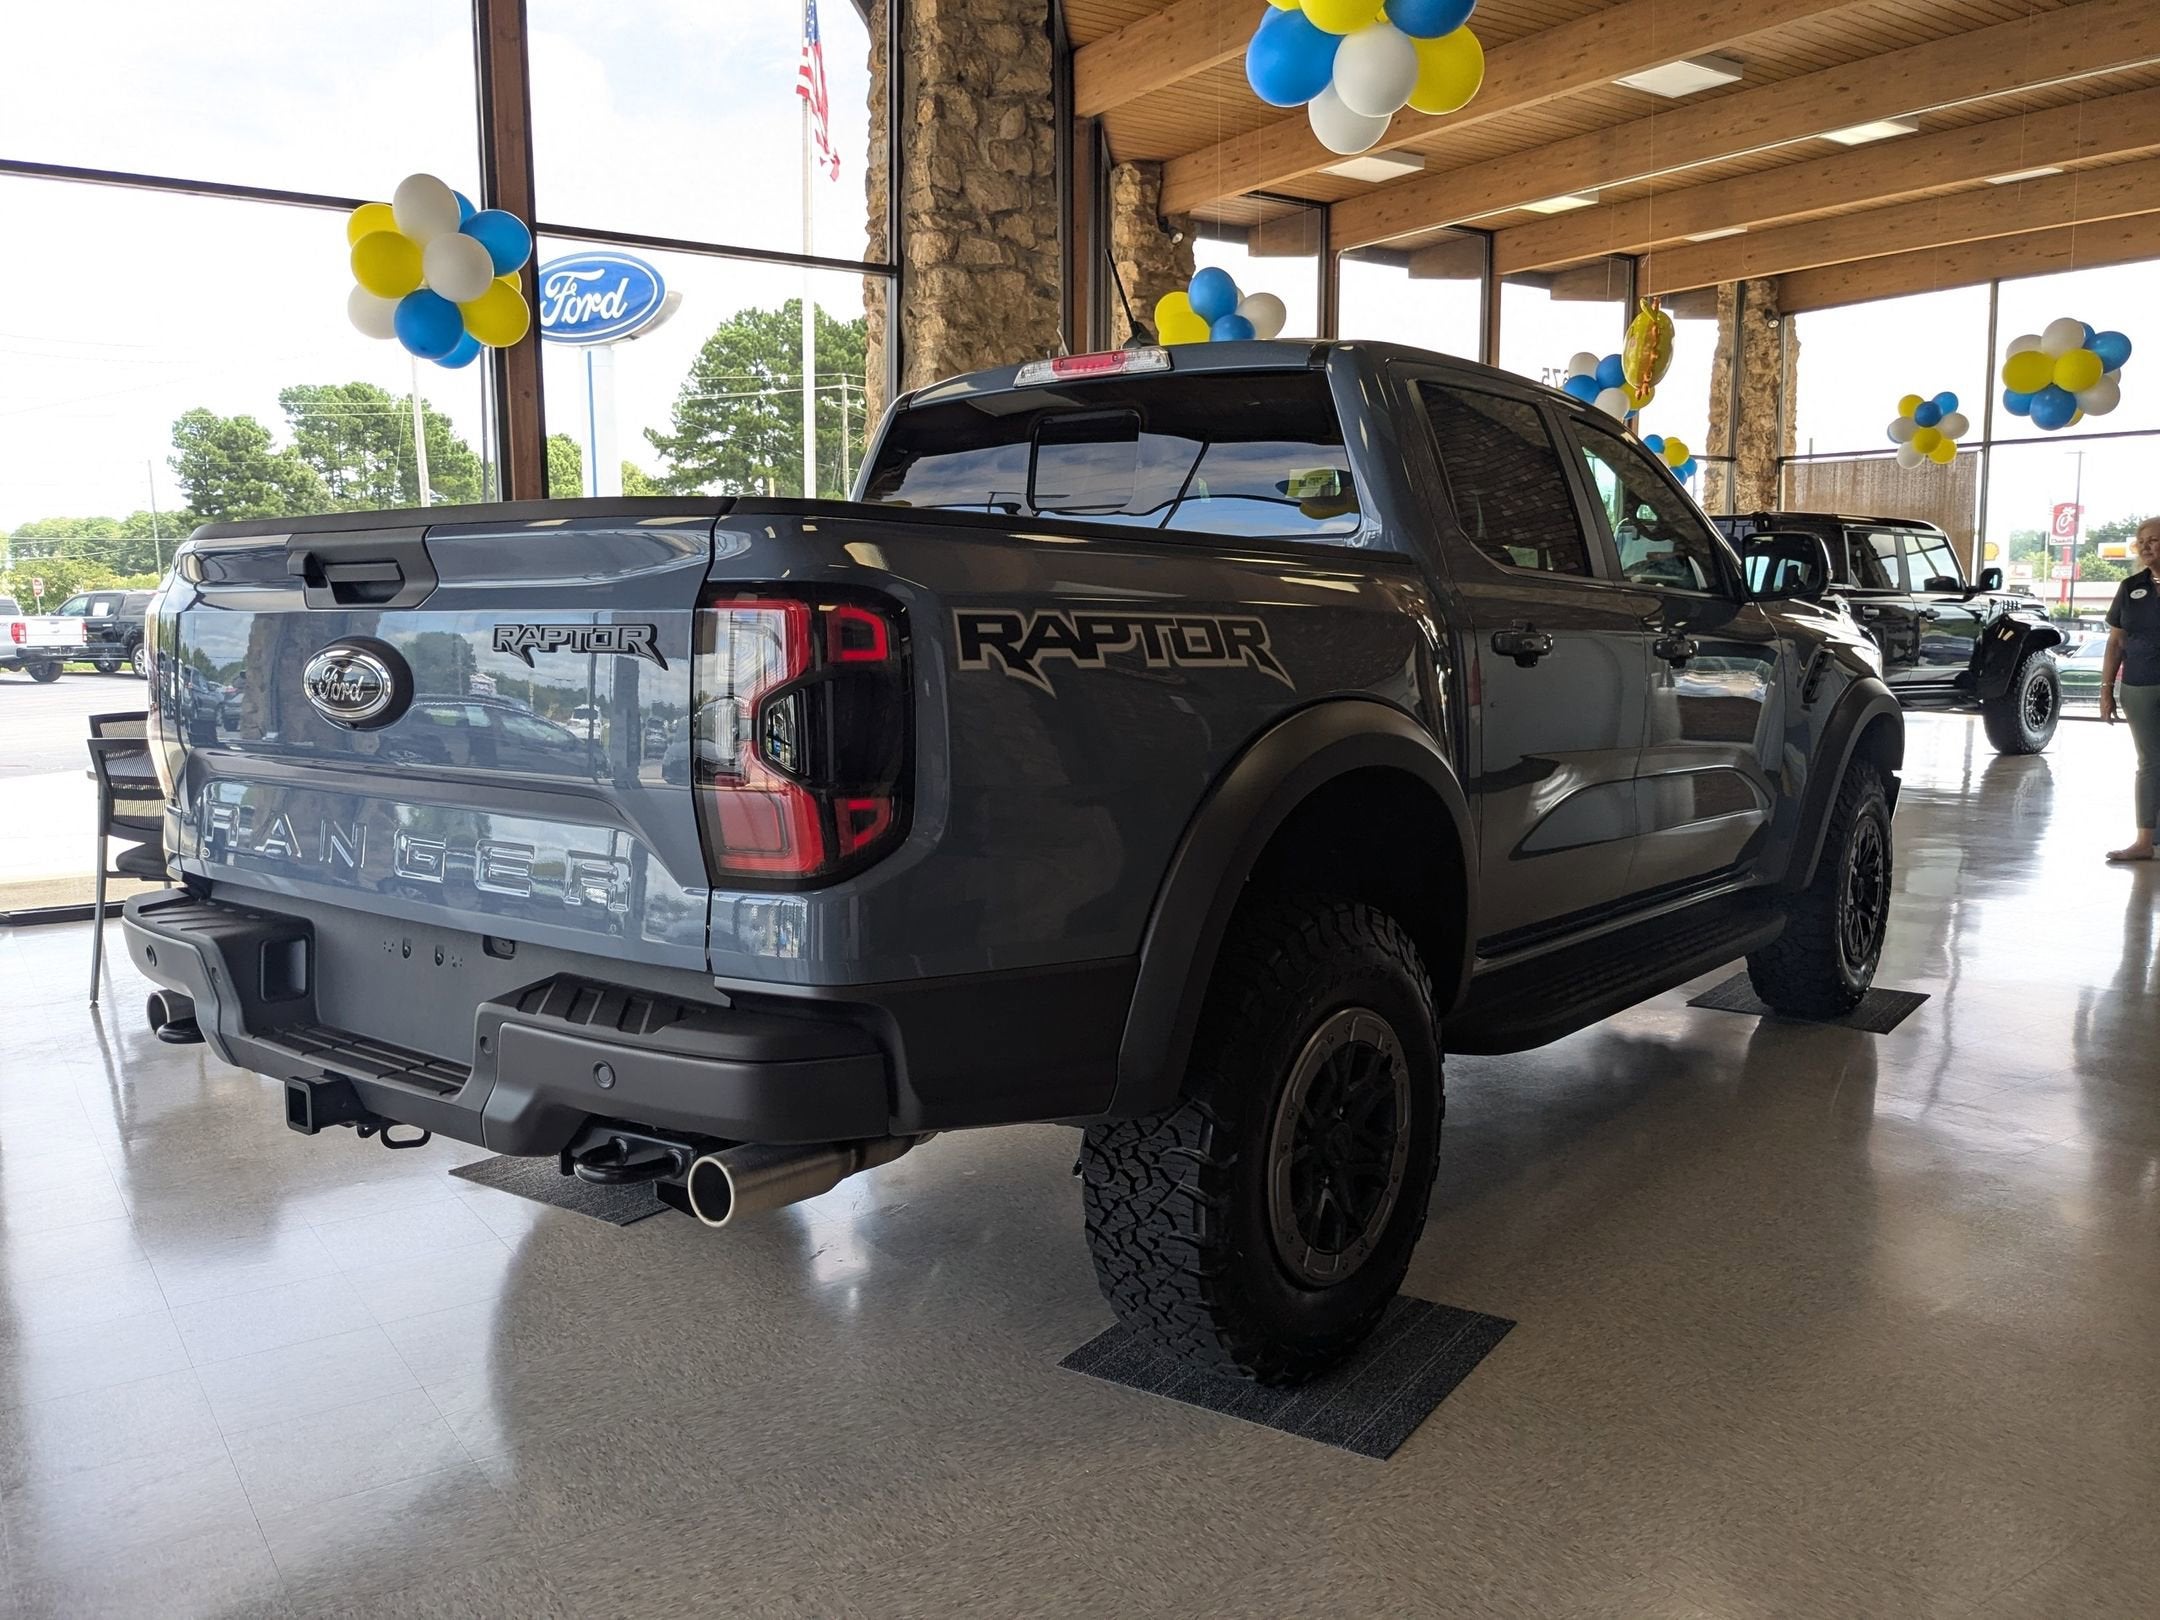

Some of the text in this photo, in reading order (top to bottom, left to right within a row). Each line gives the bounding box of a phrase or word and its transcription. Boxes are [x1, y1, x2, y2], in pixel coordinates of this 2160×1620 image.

[541, 269, 629, 326] Ford
[492, 624, 669, 671] RAPTOR
[951, 608, 1297, 699] RAPTOR
[318, 664, 364, 702] Ford
[202, 800, 634, 912] RANGER
